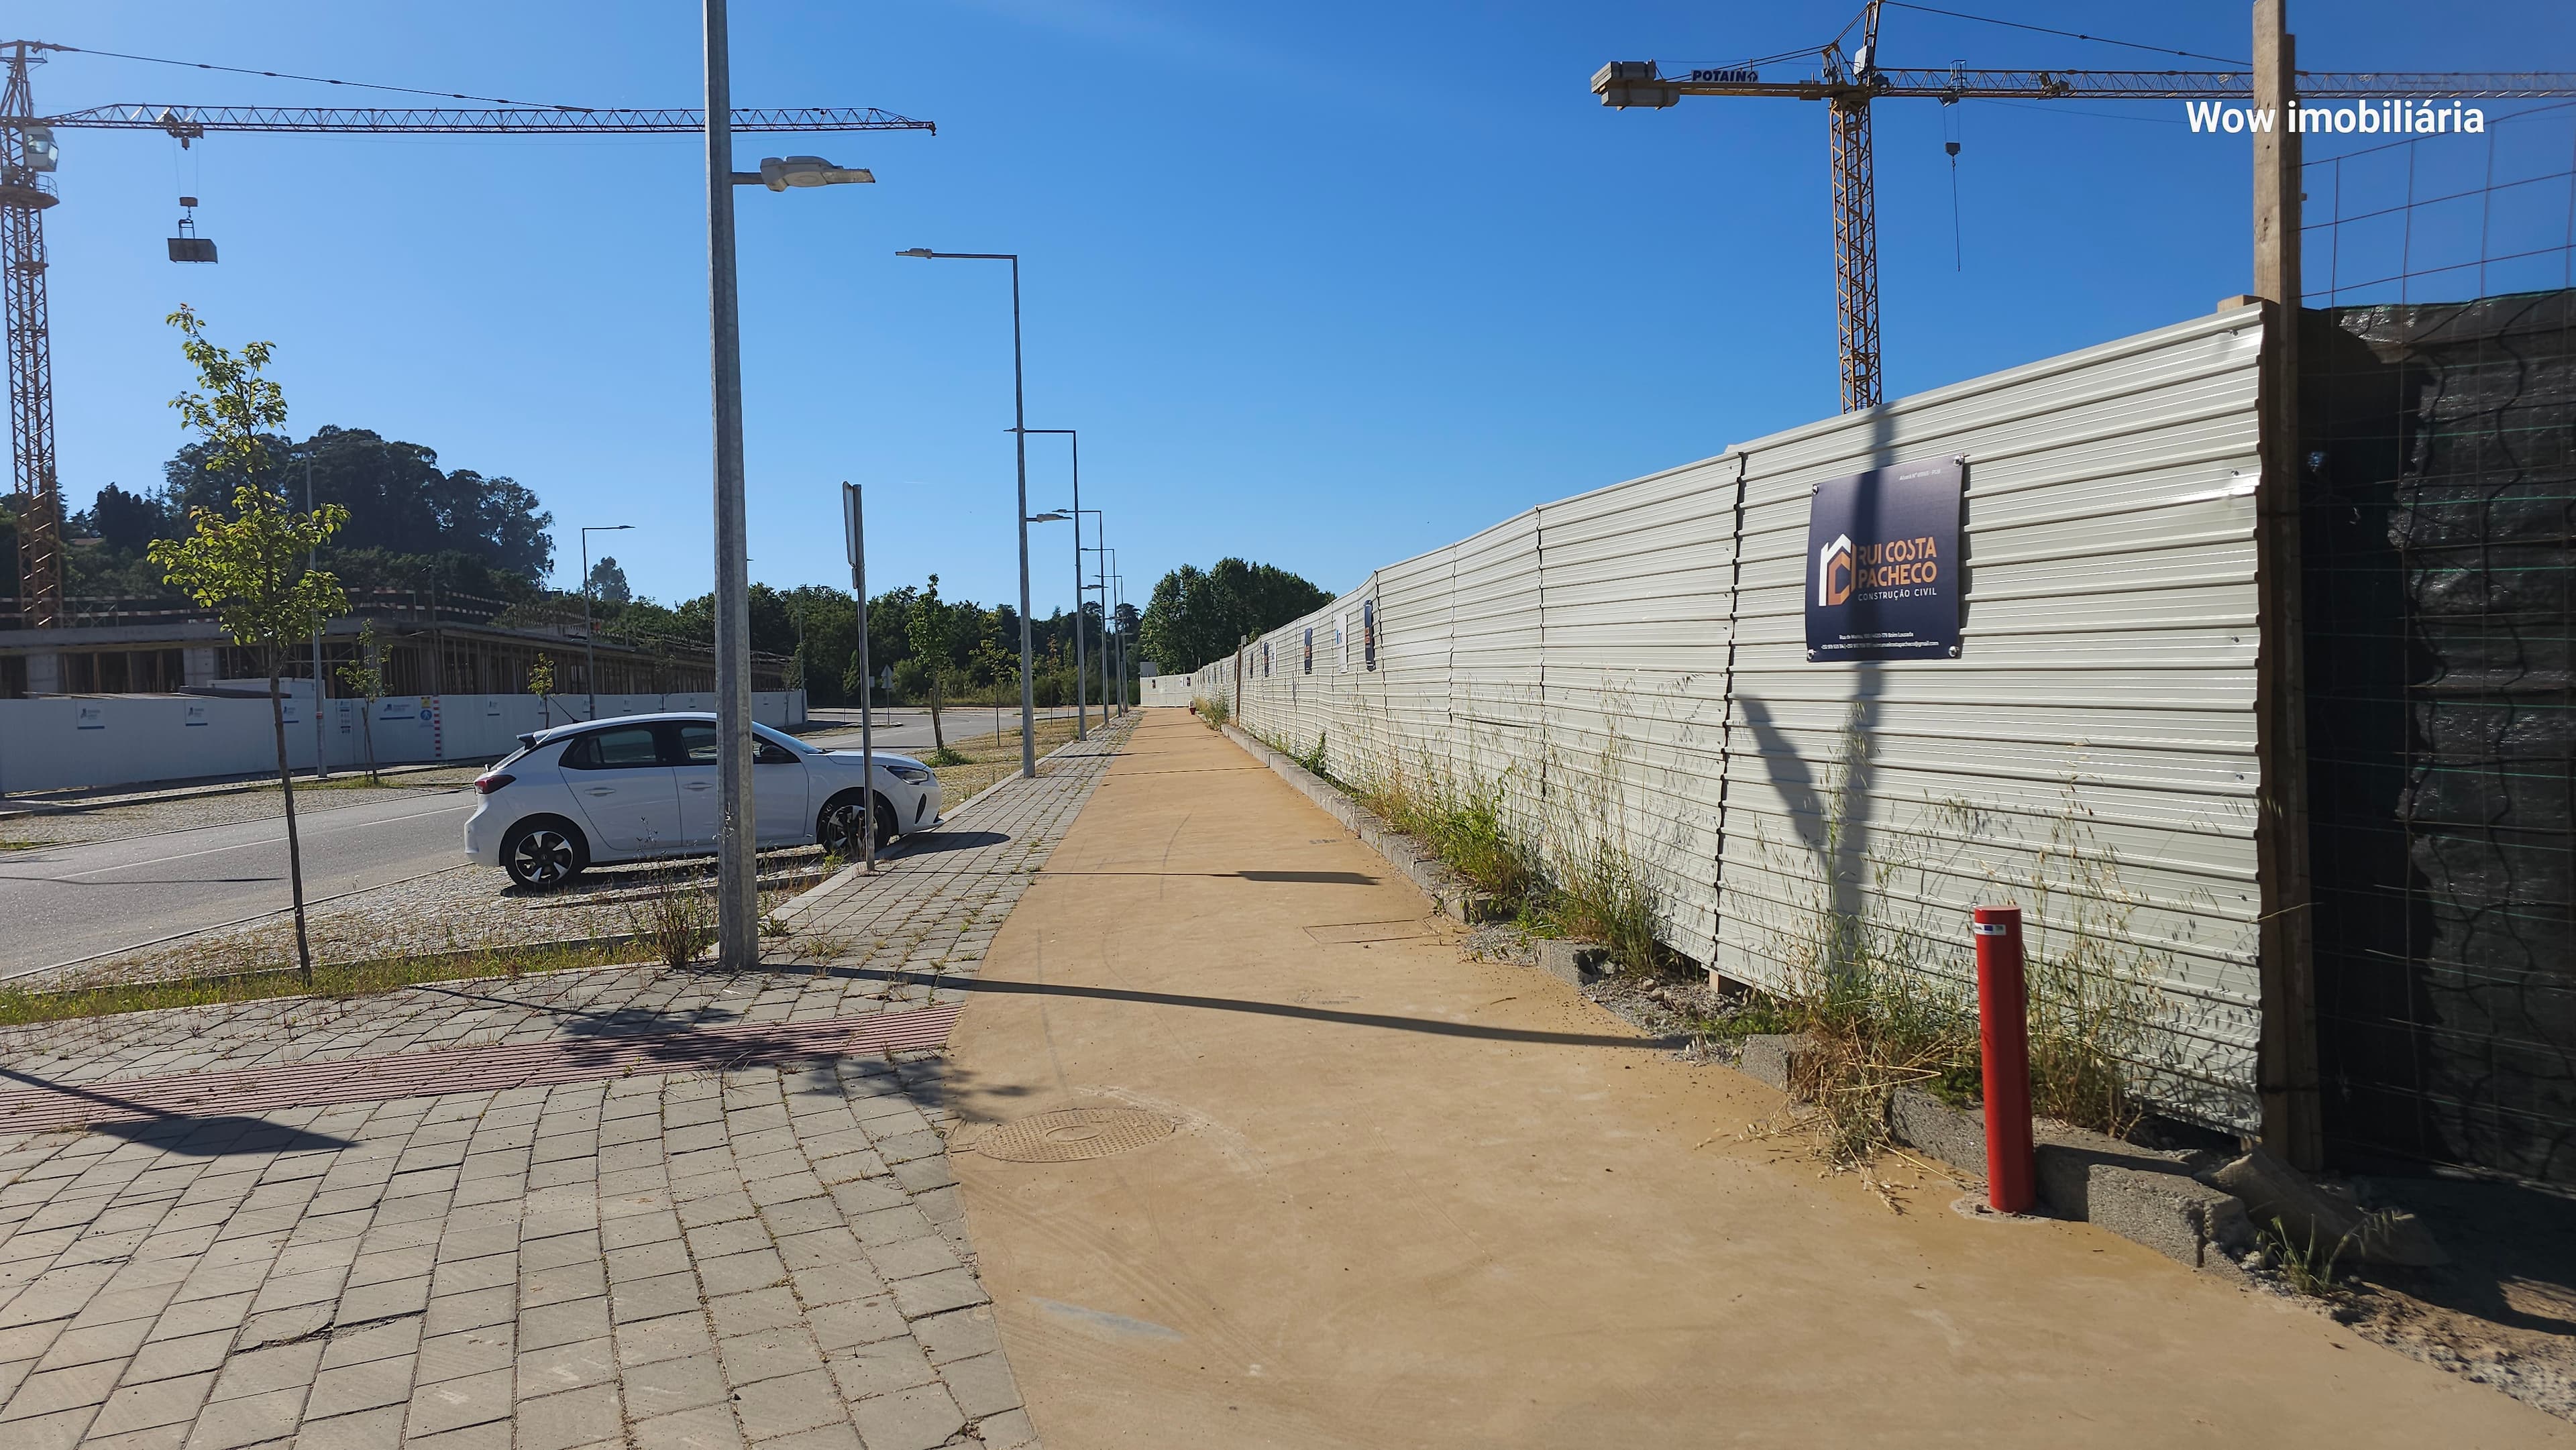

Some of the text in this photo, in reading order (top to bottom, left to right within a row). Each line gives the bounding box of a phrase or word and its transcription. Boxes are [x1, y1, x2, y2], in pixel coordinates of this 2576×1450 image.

[1693, 70, 1747, 81] POTAIN
[1859, 537, 1937, 565] RUI COSTA
[1858, 561, 1937, 588] PACHECO
[1858, 588, 1937, 601] CONSTRUÇÃO CIVIL
